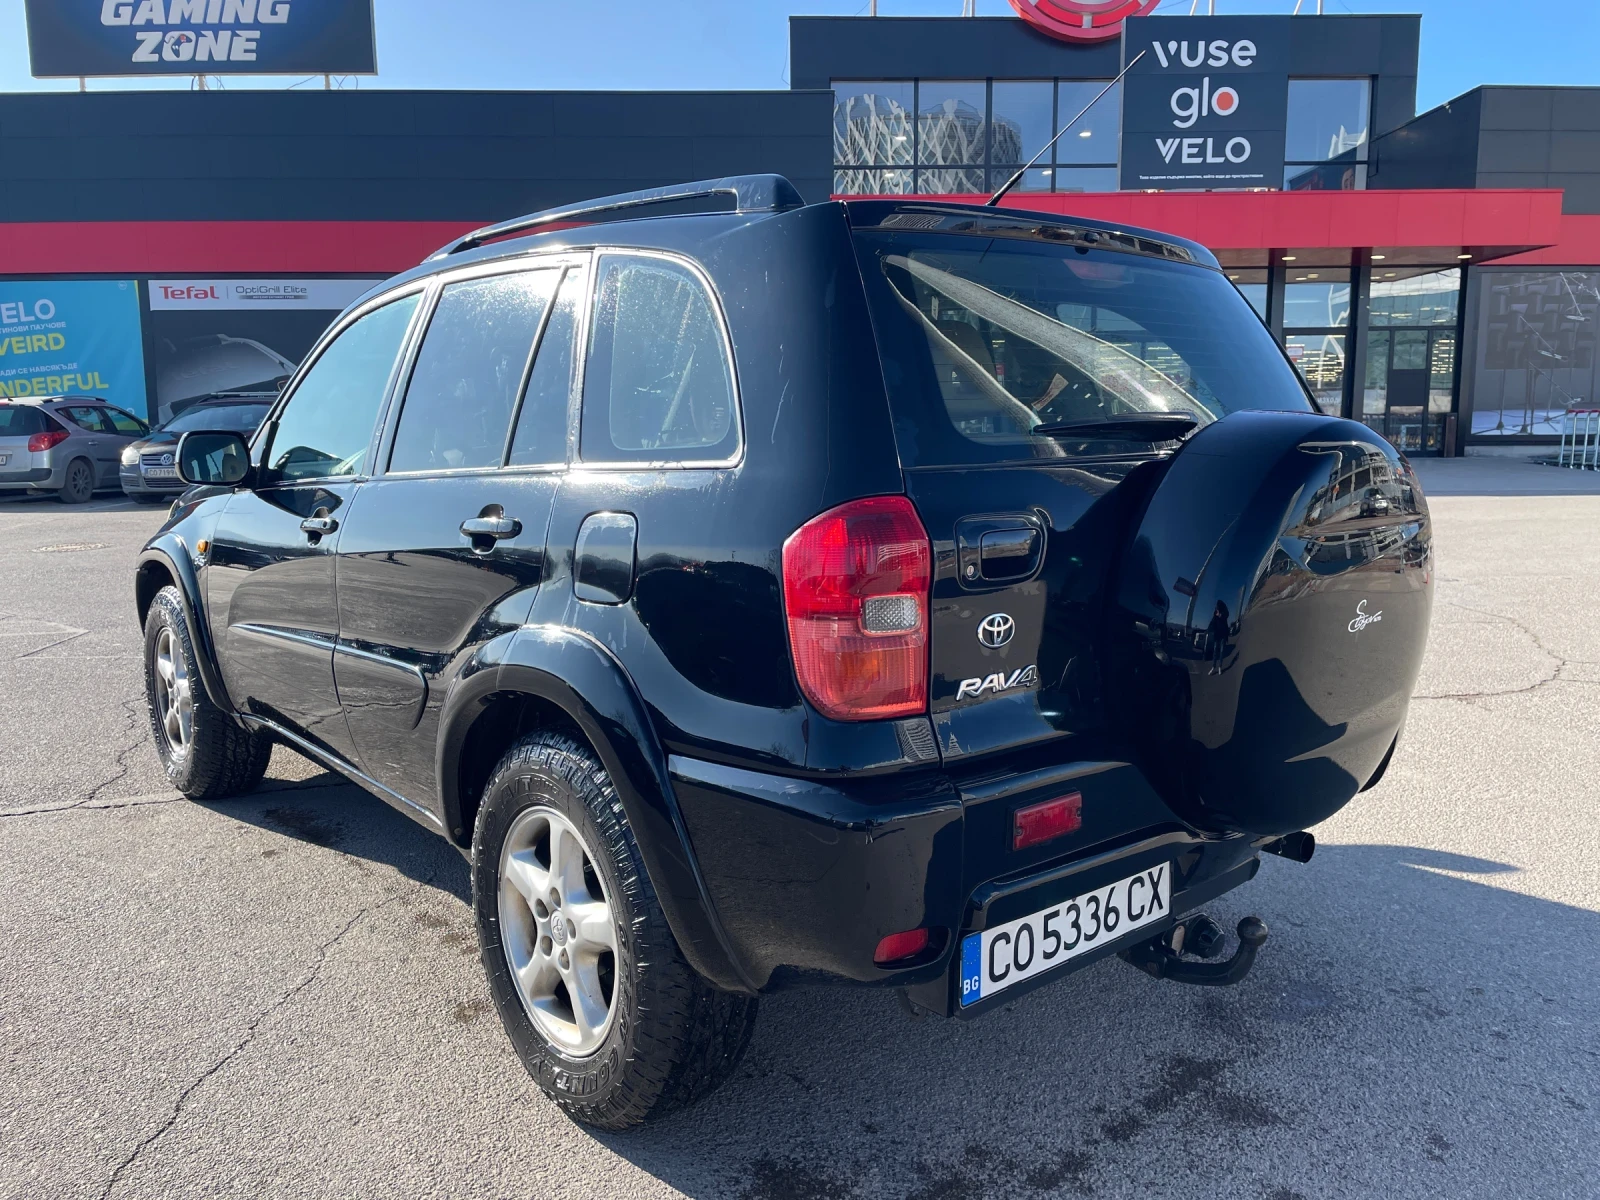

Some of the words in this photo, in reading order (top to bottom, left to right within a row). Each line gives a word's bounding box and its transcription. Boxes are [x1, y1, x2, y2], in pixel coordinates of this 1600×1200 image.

[101, 0, 291, 26] GAMING
[132, 30, 261, 62] ZONE
[1170, 76, 1239, 128] glo
[1155, 136, 1251, 164] VELO
[159, 286, 219, 299] Tefal
[235, 285, 281, 295] OptiGrill
[283, 285, 308, 294] Elite
[30, 321, 67, 331] ПАУЧОВЕ
[30, 362, 78, 373] НАВСЯКЪДЕ
[956, 664, 1038, 701] RAV4
[1043, 886, 1121, 960] 5336
[1127, 866, 1164, 922] CX
[963, 975, 979, 995] BG
